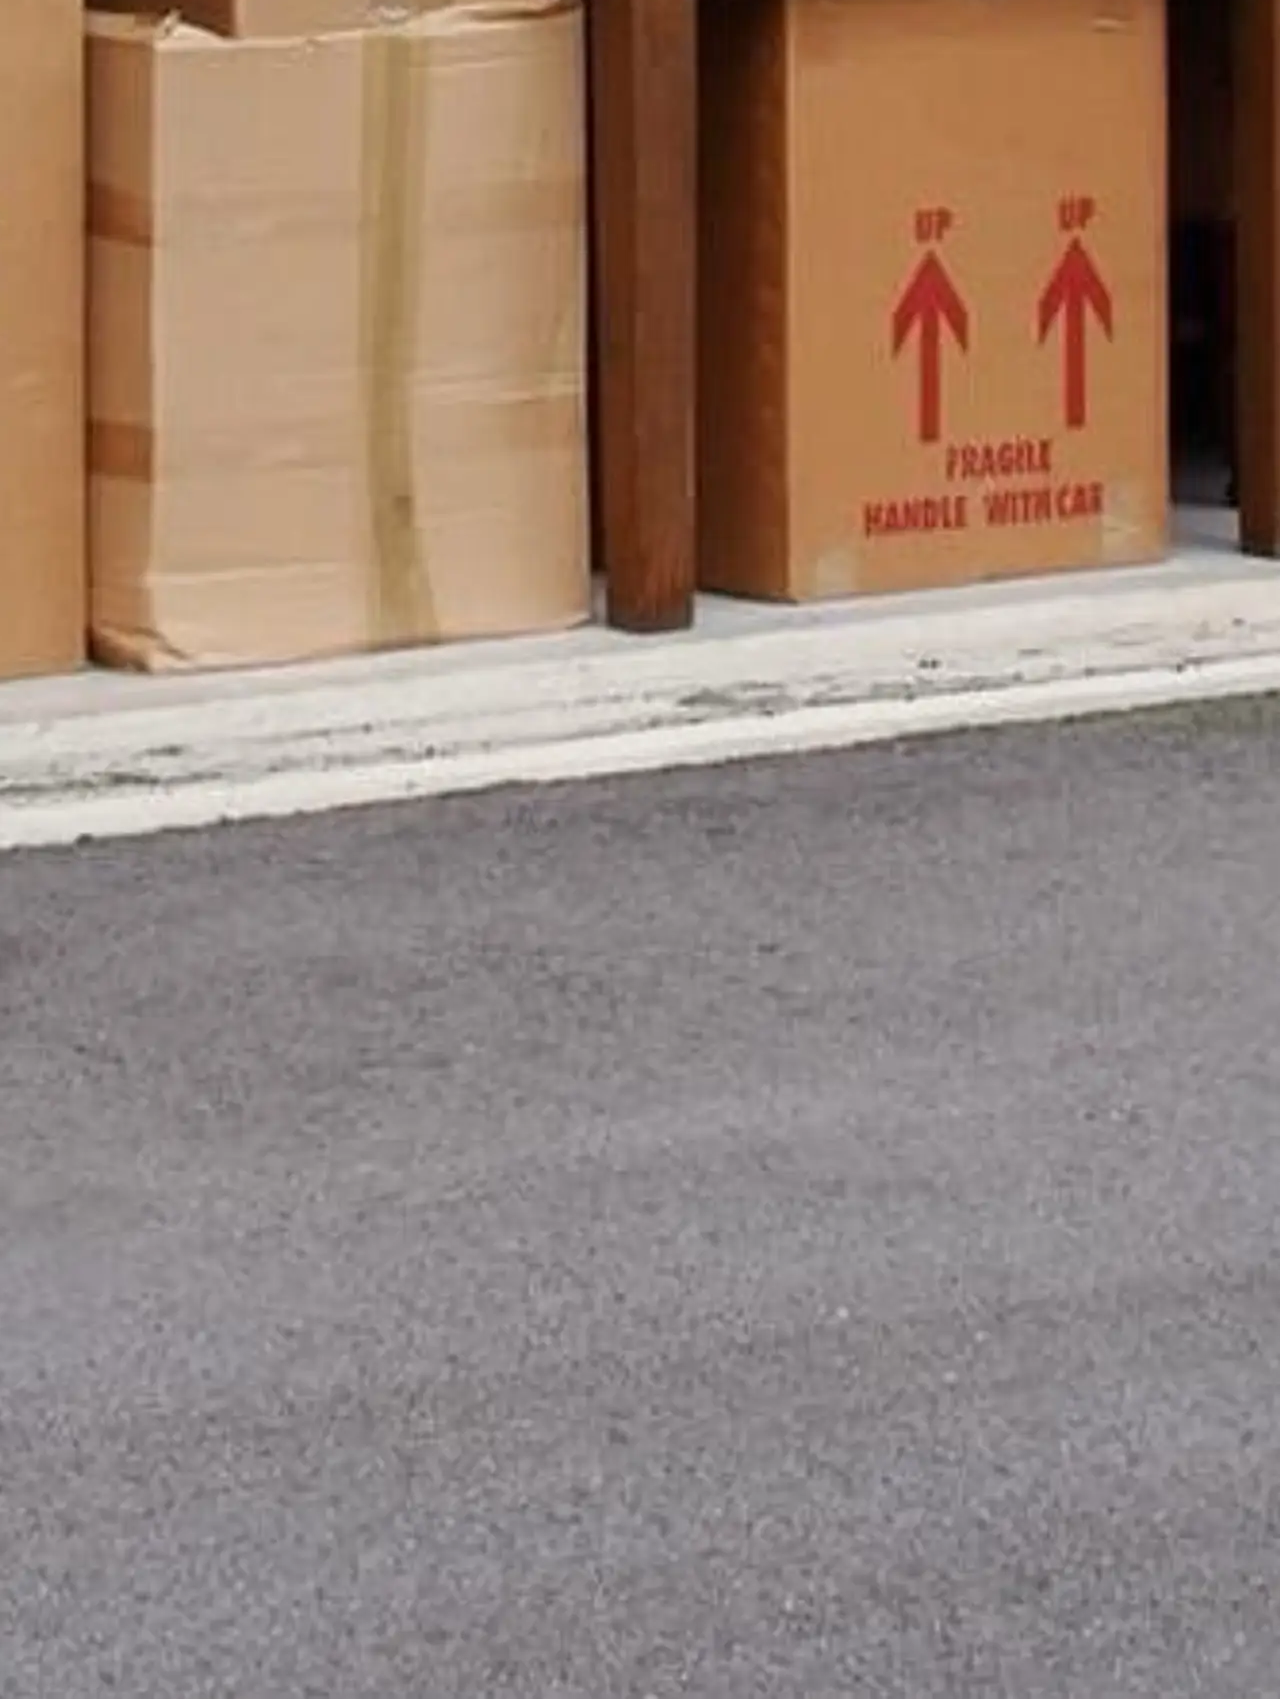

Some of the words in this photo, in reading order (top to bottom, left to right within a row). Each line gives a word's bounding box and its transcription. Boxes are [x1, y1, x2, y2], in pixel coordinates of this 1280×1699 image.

[915, 208, 951, 241] UP
[1060, 197, 1094, 232] UP
[946, 438, 1051, 480] FRAGILE
[865, 495, 967, 538] HANDLE
[983, 488, 1052, 526] WITH
